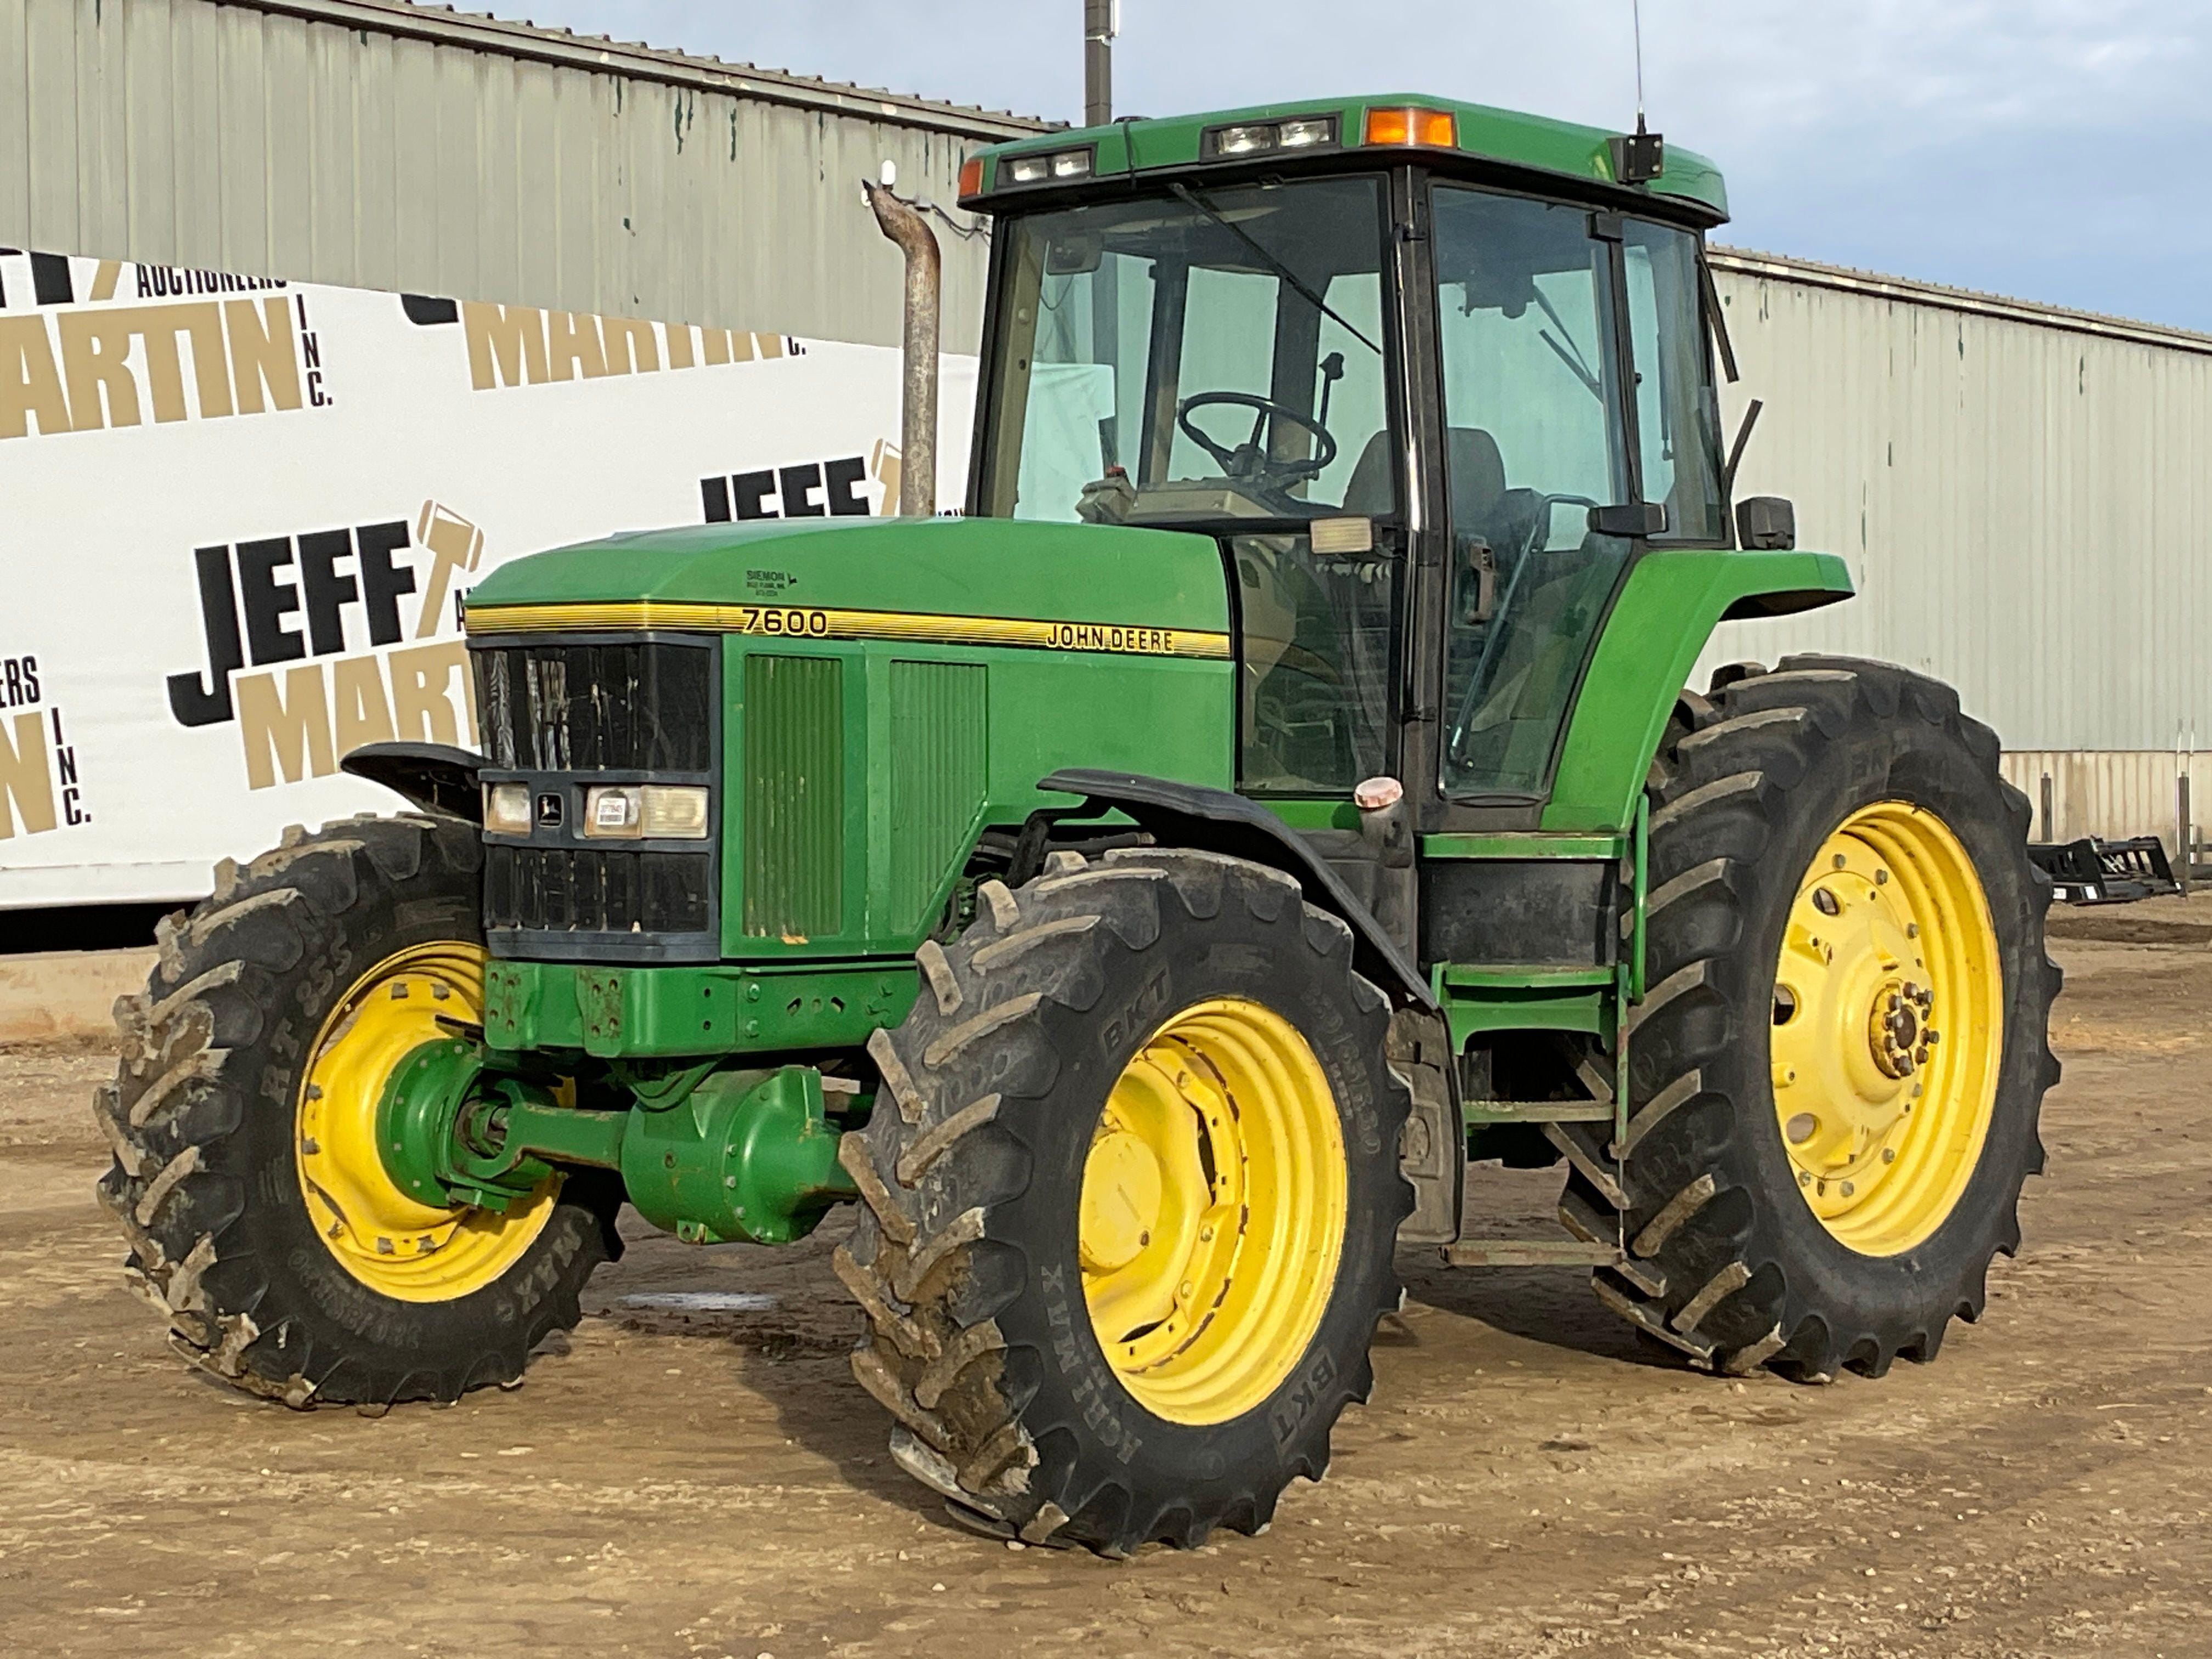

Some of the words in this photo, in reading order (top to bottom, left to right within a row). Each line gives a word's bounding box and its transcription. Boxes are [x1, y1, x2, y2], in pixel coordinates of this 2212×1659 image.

[462, 301, 783, 391] MAR
[167, 520, 416, 727] JEFF
[742, 609, 826, 634] 7600
[1047, 625, 1103, 647] JOHN
[1111, 629, 1172, 651] DEERE
[1103, 967, 1172, 1049] BKT
[1271, 1351, 1336, 1447] BKT
